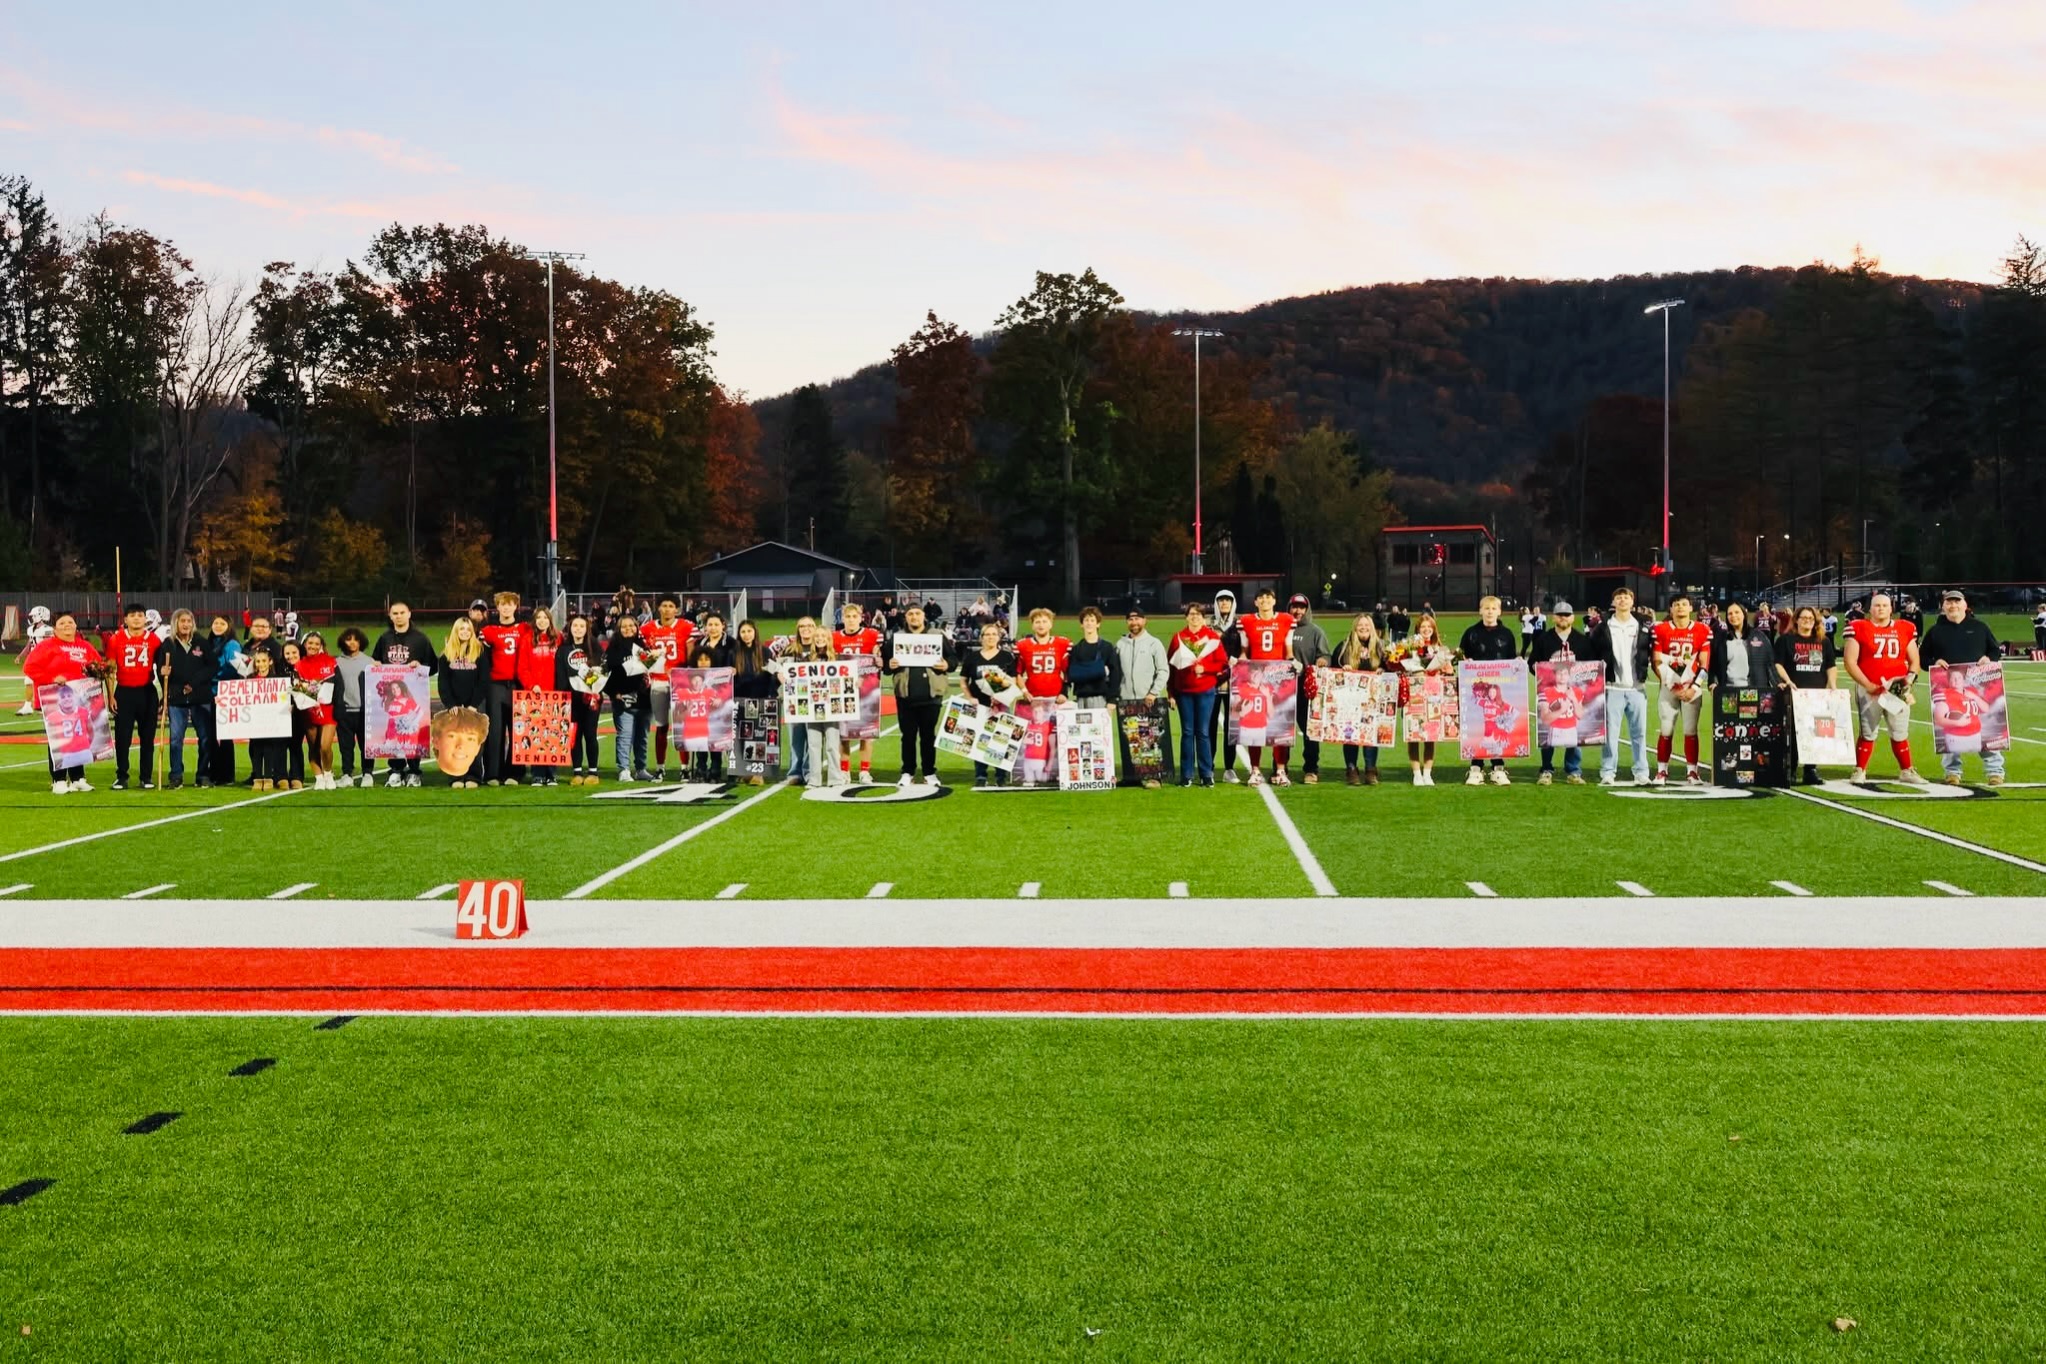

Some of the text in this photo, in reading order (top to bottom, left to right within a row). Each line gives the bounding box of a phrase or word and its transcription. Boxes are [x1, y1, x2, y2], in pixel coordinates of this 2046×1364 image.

[504, 637, 516, 655] 3
[1262, 631, 1273, 652] 8
[1873, 638, 1899, 659] 70
[124, 646, 149, 667] 24
[1032, 655, 1056, 674] 58
[788, 665, 849, 679] SENIOR
[219, 679, 287, 695] DEMETRIANA
[218, 692, 278, 708] COLEMAN
[516, 692, 568, 701] EASTON
[1254, 696, 1263, 713] 8
[690, 702, 707, 718] 23
[63, 719, 84, 738] 24
[541, 719, 547, 727] 3
[515, 754, 567, 763] SENIOR
[746, 762, 765, 773] #23
[1068, 781, 1111, 791] JOHNSON
[457, 881, 518, 938] 40
